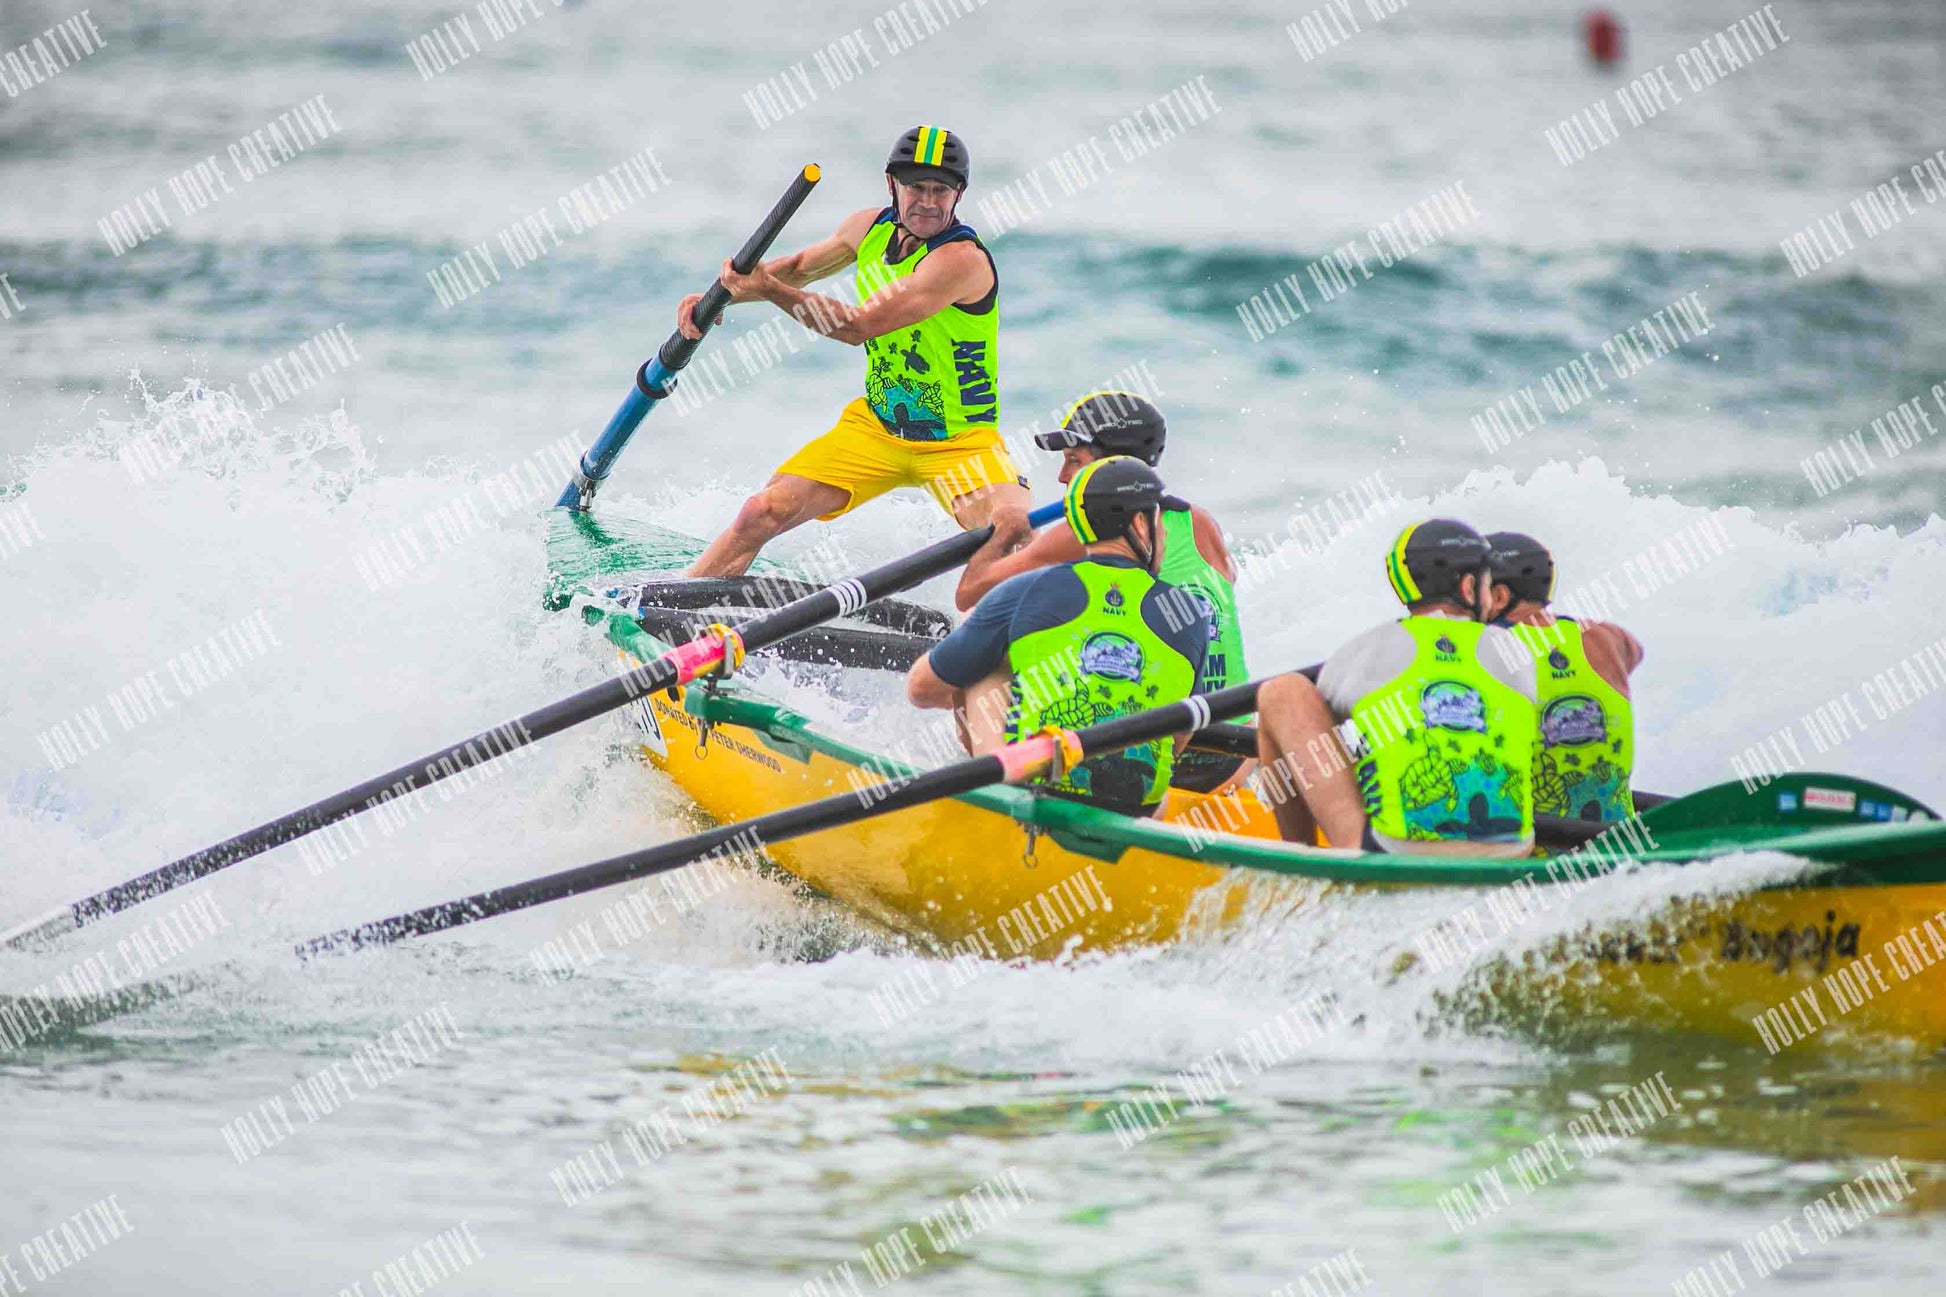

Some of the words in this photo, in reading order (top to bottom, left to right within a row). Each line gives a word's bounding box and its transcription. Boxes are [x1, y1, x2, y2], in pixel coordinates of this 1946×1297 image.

[951, 339, 998, 422] NAVY
[1102, 606, 1127, 616] NAVY
[1435, 654, 1462, 664] NAVY
[1551, 669, 1577, 680] NAVY
[655, 697, 688, 727] DONATED
[710, 727, 735, 750] PETER
[734, 740, 782, 773] SHERWOOD
